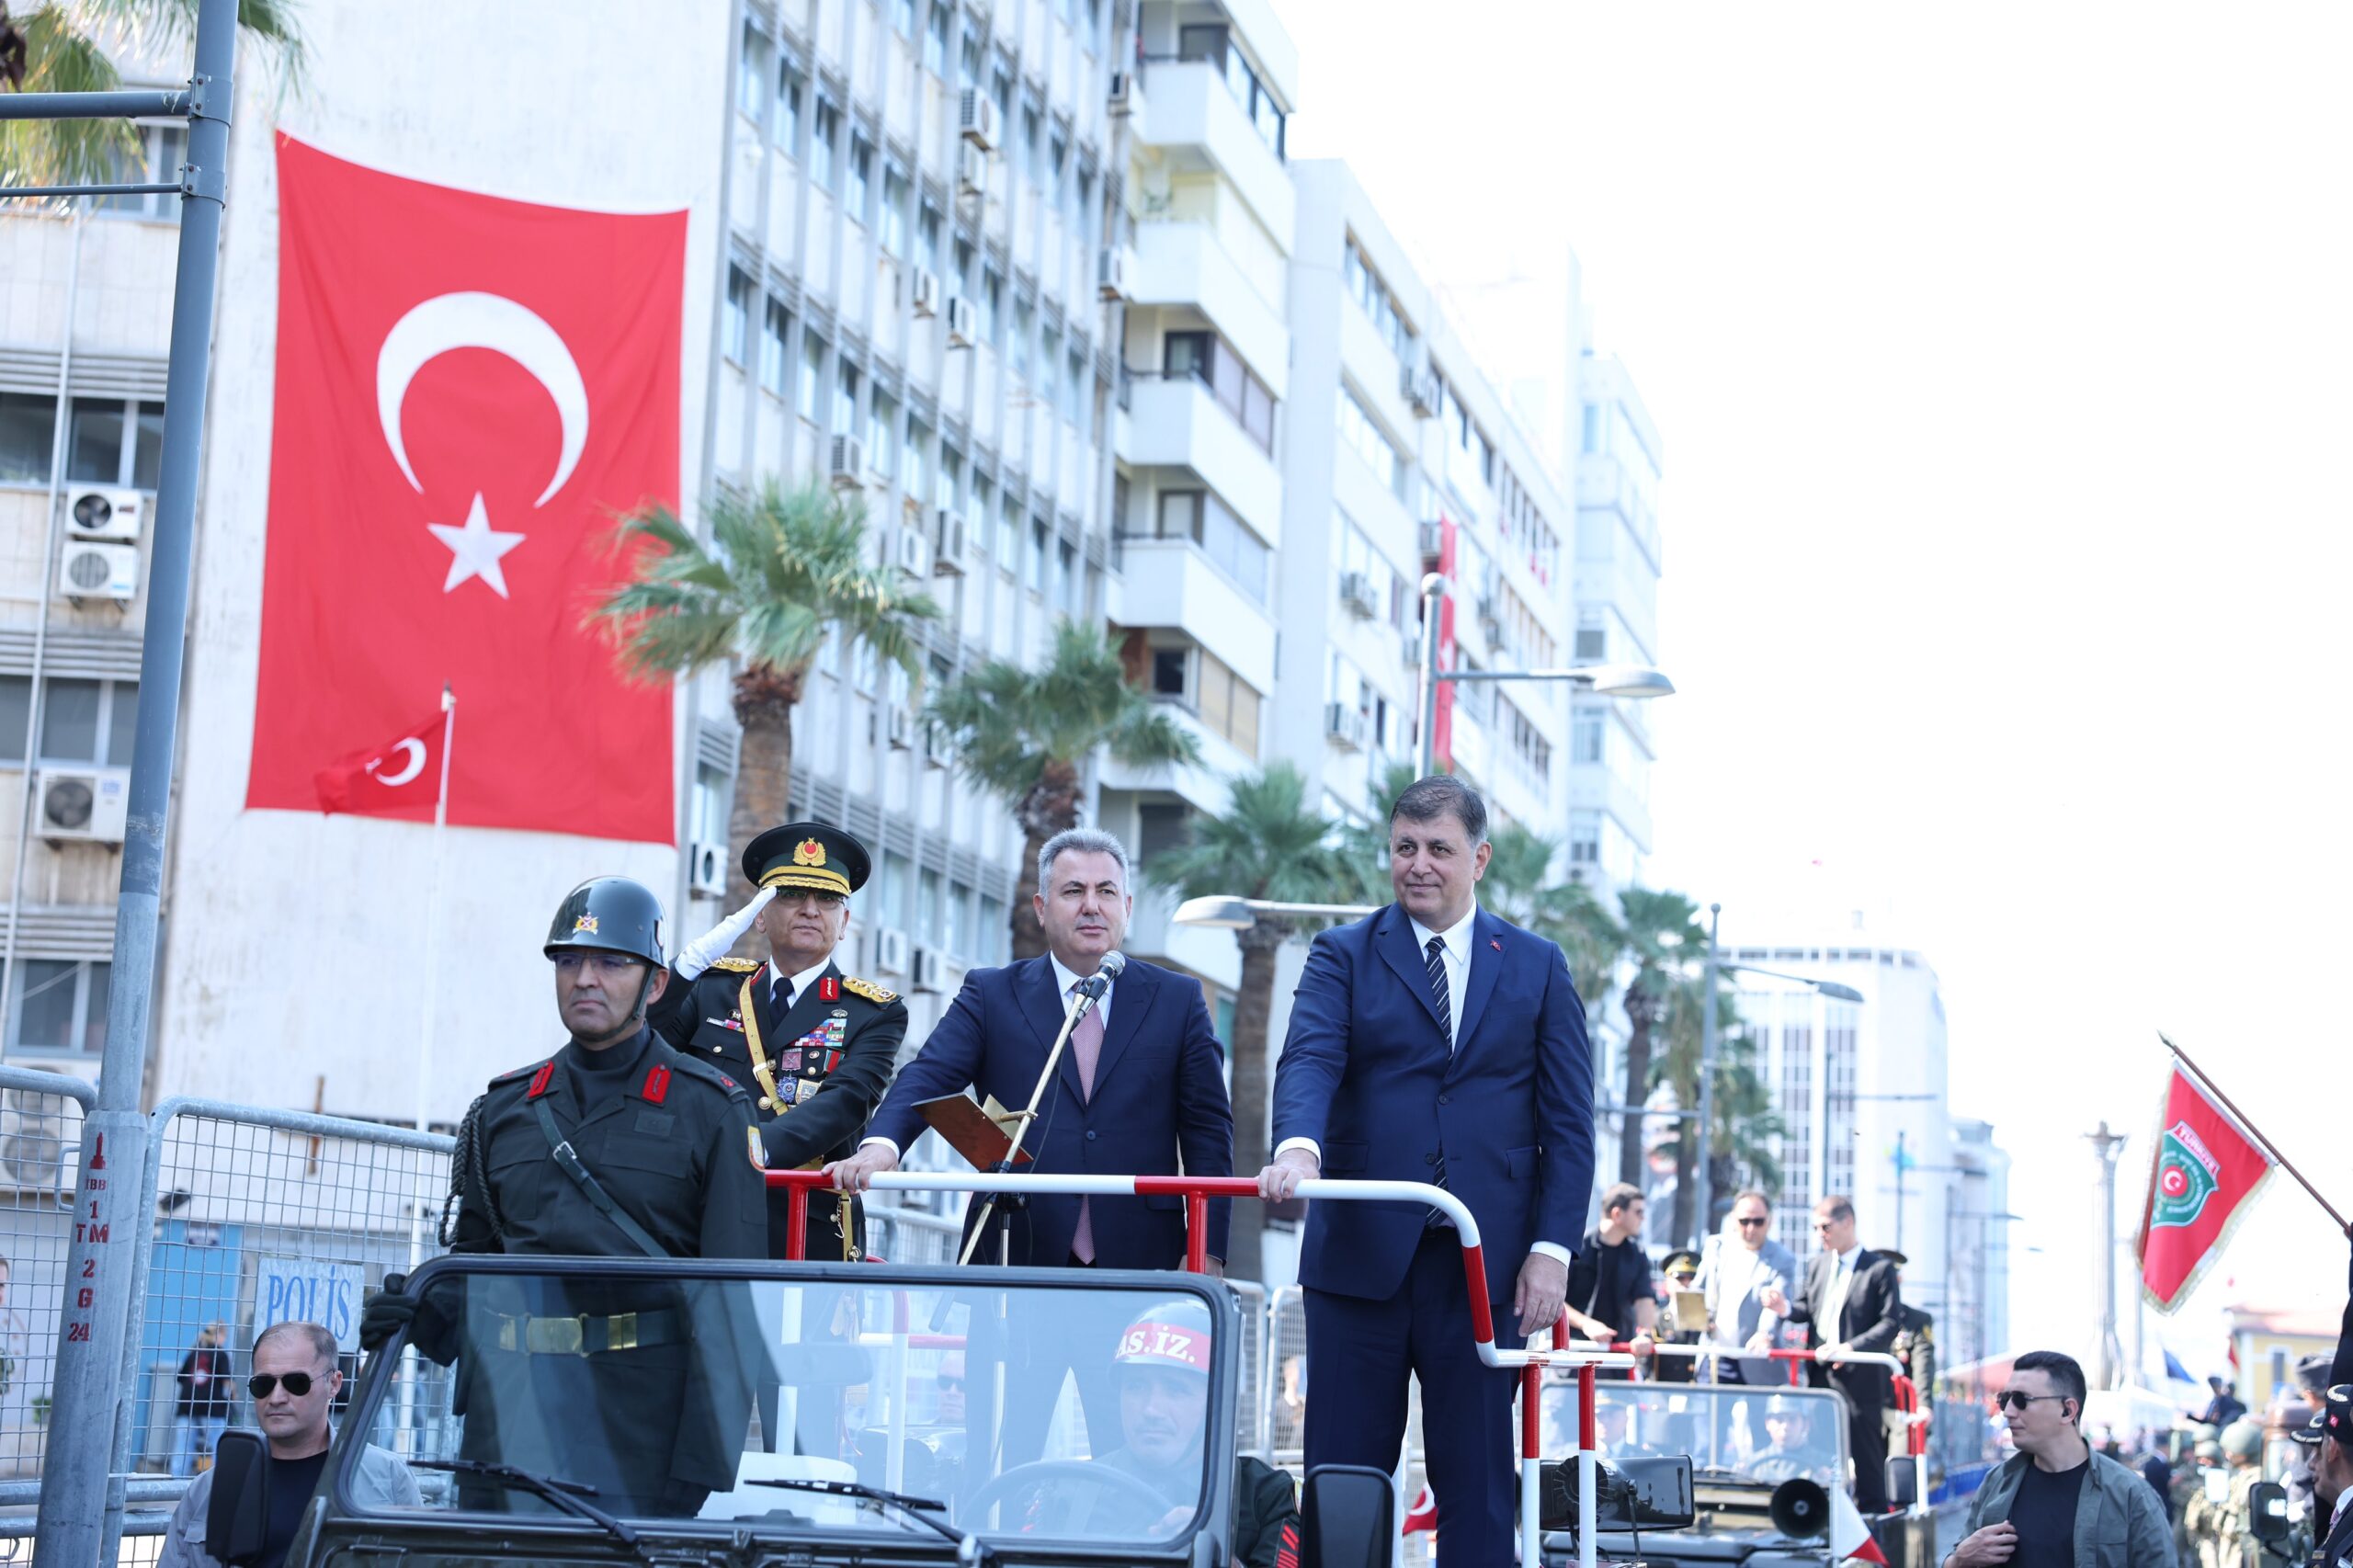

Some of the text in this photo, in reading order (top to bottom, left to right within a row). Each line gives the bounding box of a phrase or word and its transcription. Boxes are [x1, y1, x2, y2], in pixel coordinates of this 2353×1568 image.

[89, 1200, 98, 1219] 1
[83, 1259, 96, 1278] 2
[267, 1265, 351, 1340] POLİS
[67, 1323, 90, 1341] 24
[1115, 1325, 1195, 1363] AS.İZ.
